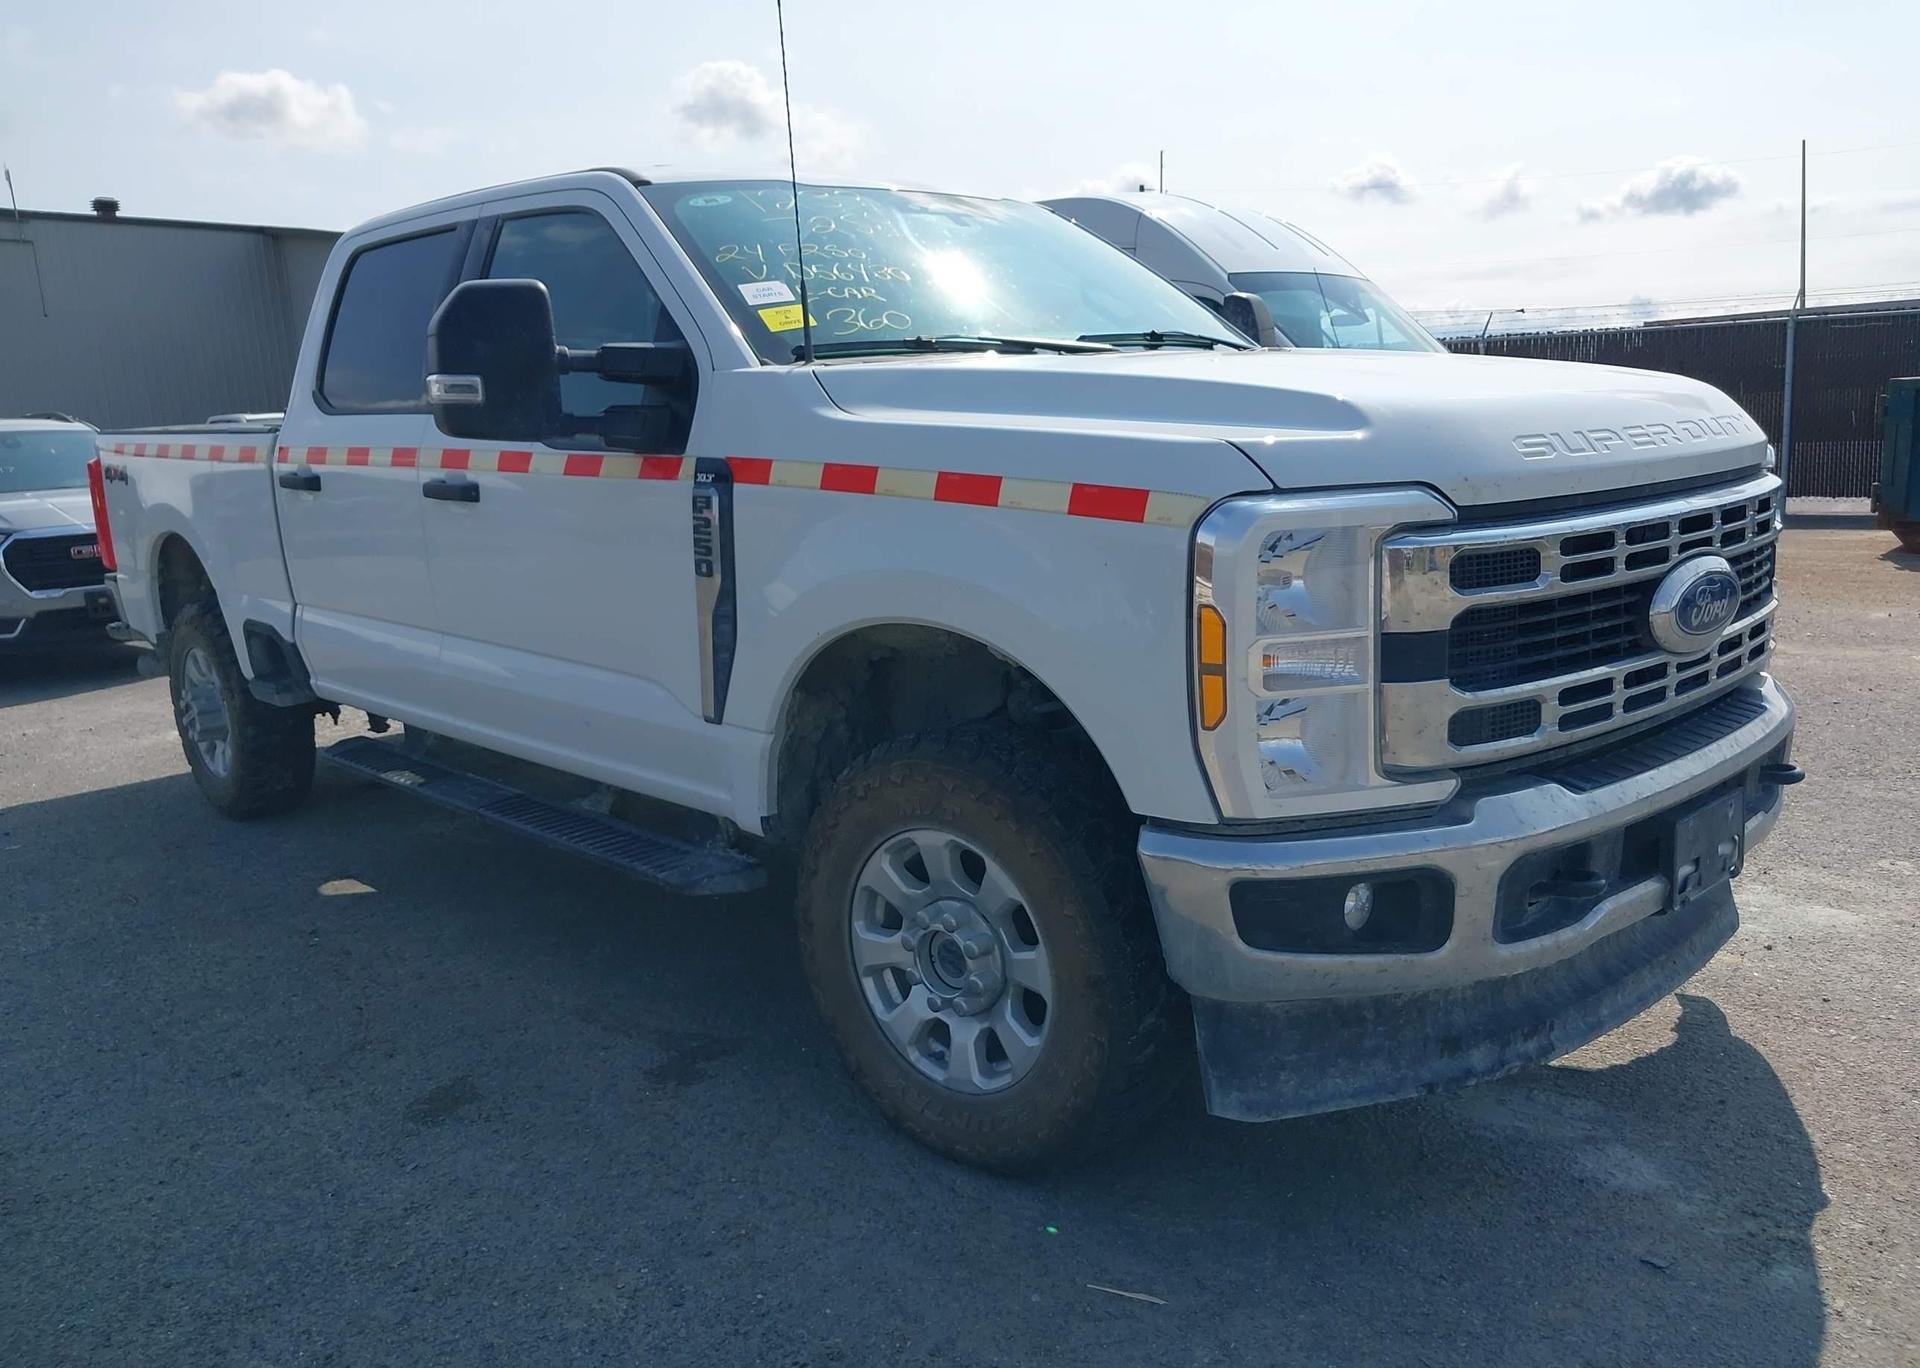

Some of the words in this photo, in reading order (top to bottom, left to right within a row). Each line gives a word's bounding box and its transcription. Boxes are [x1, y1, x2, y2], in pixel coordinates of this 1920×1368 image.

[715, 243, 766, 263] 24
[826, 307, 912, 336] 360
[1511, 422, 1684, 462] SUPER
[1675, 413, 1752, 443] DUTY
[1690, 583, 1732, 627] Ford
